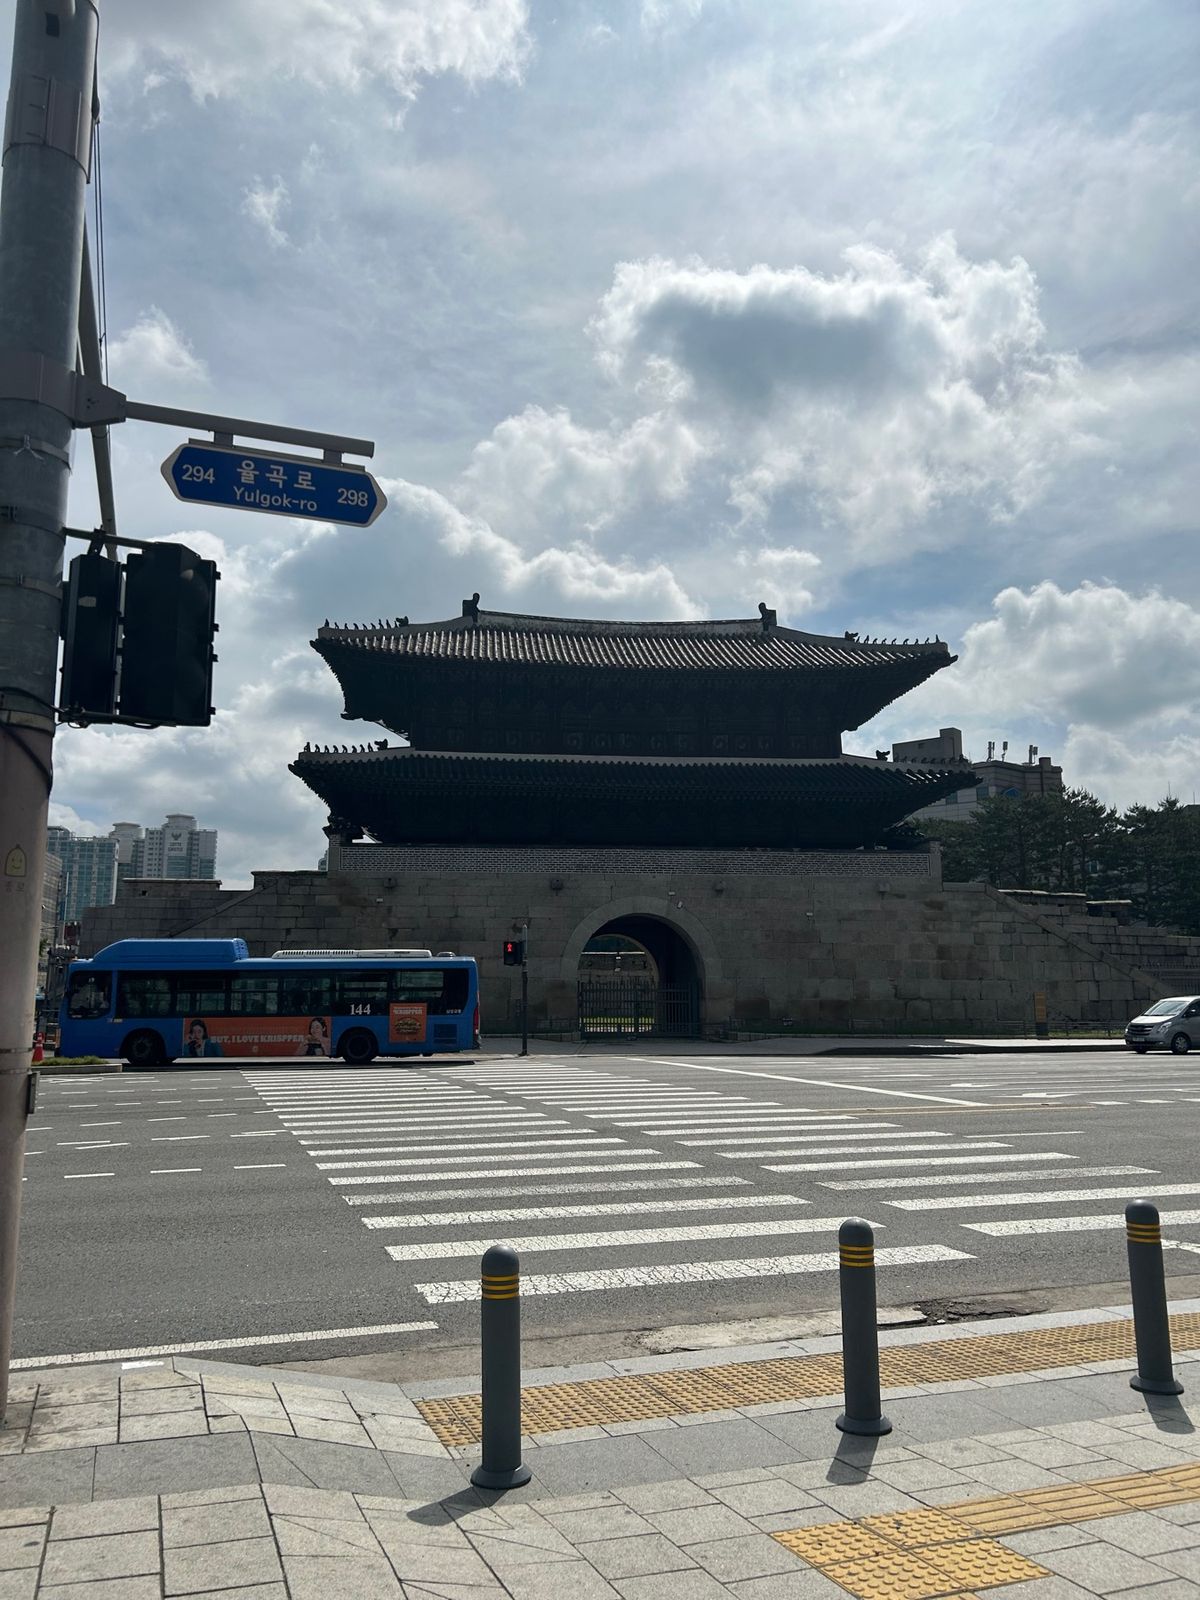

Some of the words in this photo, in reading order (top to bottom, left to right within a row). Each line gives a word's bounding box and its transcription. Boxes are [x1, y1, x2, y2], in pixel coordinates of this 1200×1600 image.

[181, 464, 215, 484] 294
[236, 460, 316, 490] 율곡로
[233, 486, 317, 511] Yulgok-ro
[337, 488, 368, 507] 298
[350, 1003, 371, 1015] 144
[231, 1035, 236, 1043] I
[236, 1035, 259, 1043] LOVE
